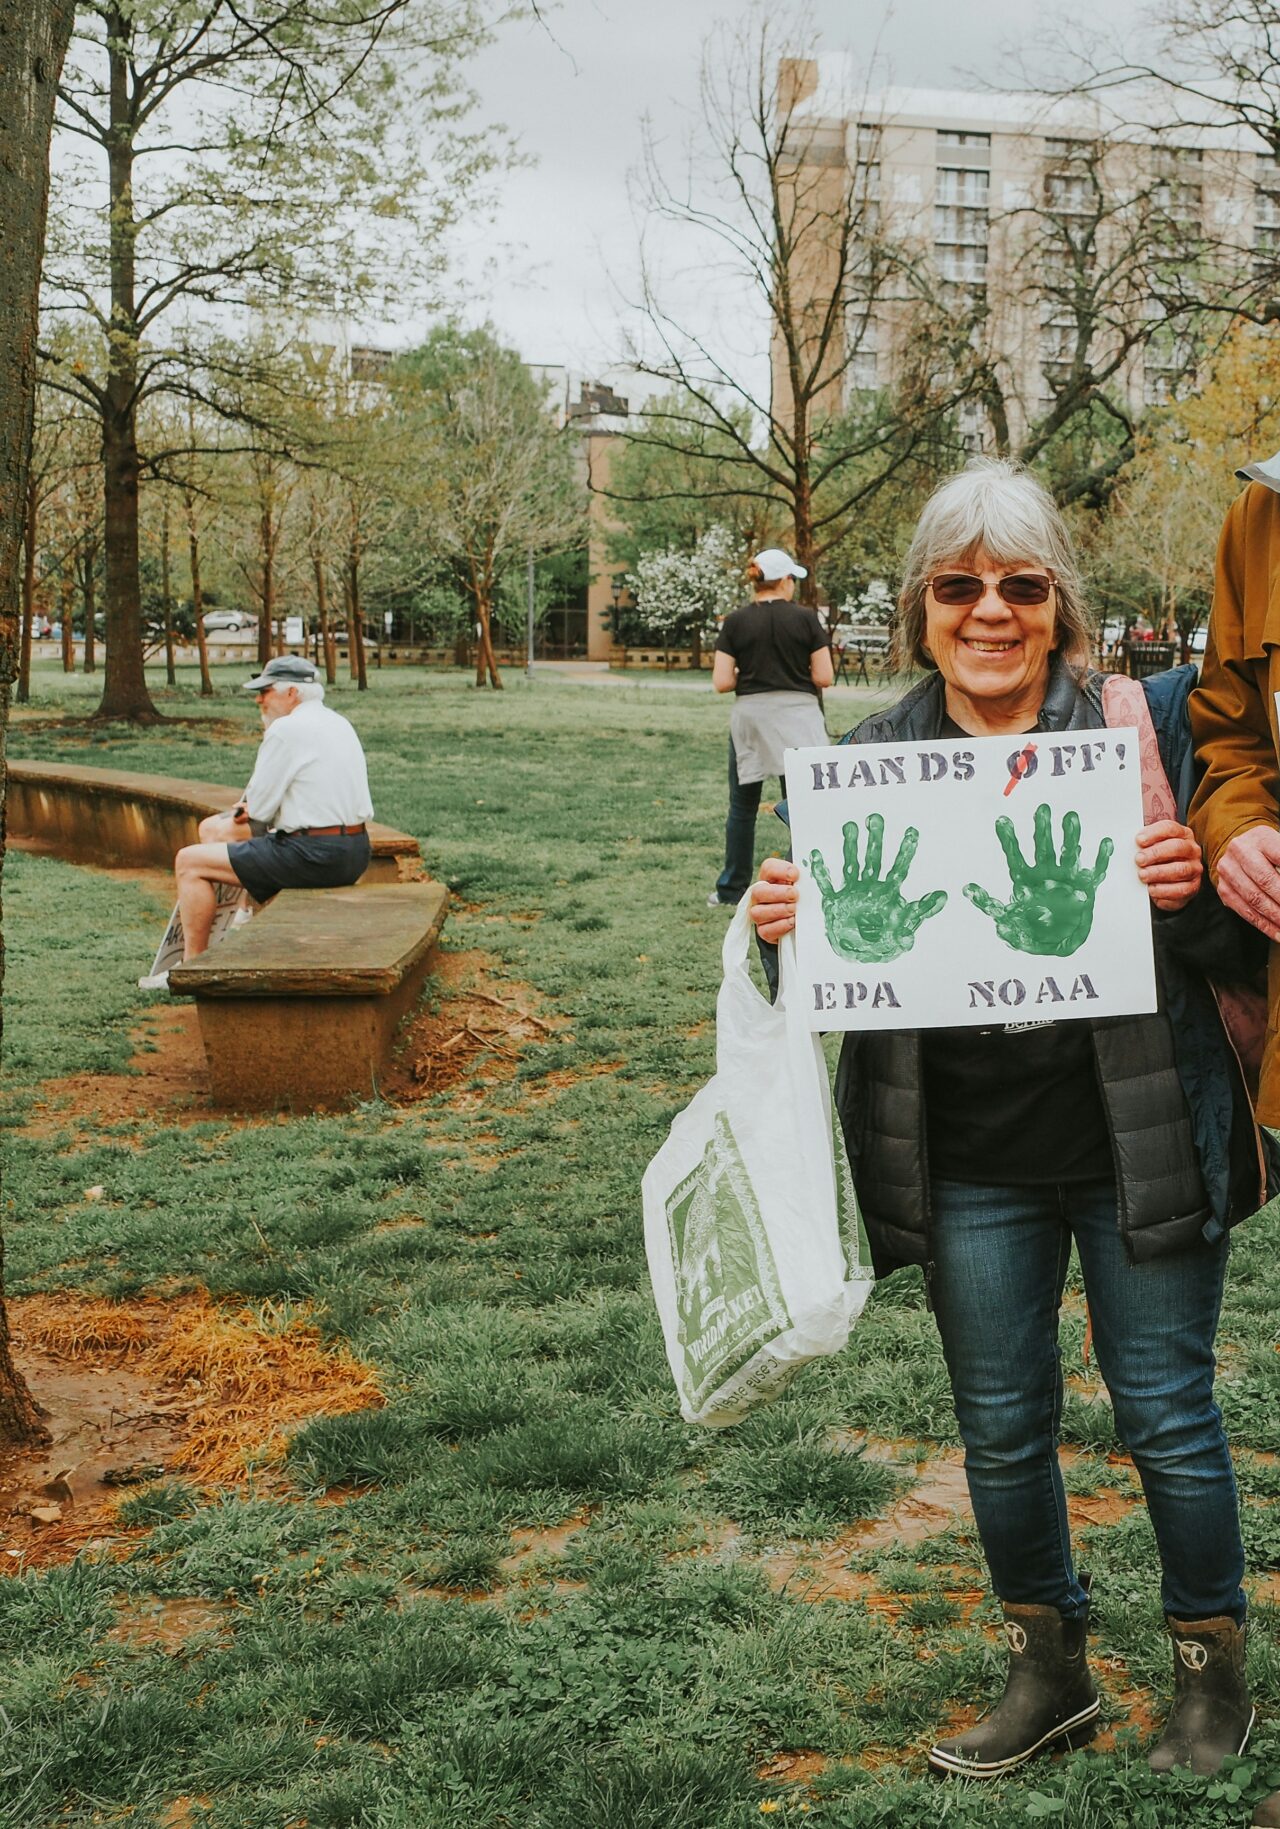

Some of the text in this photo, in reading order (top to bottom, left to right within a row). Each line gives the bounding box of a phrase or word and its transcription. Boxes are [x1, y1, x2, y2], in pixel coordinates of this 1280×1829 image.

[810, 741, 1127, 791] HANDS OFF!
[812, 973, 1099, 1011] EPA NOAA
